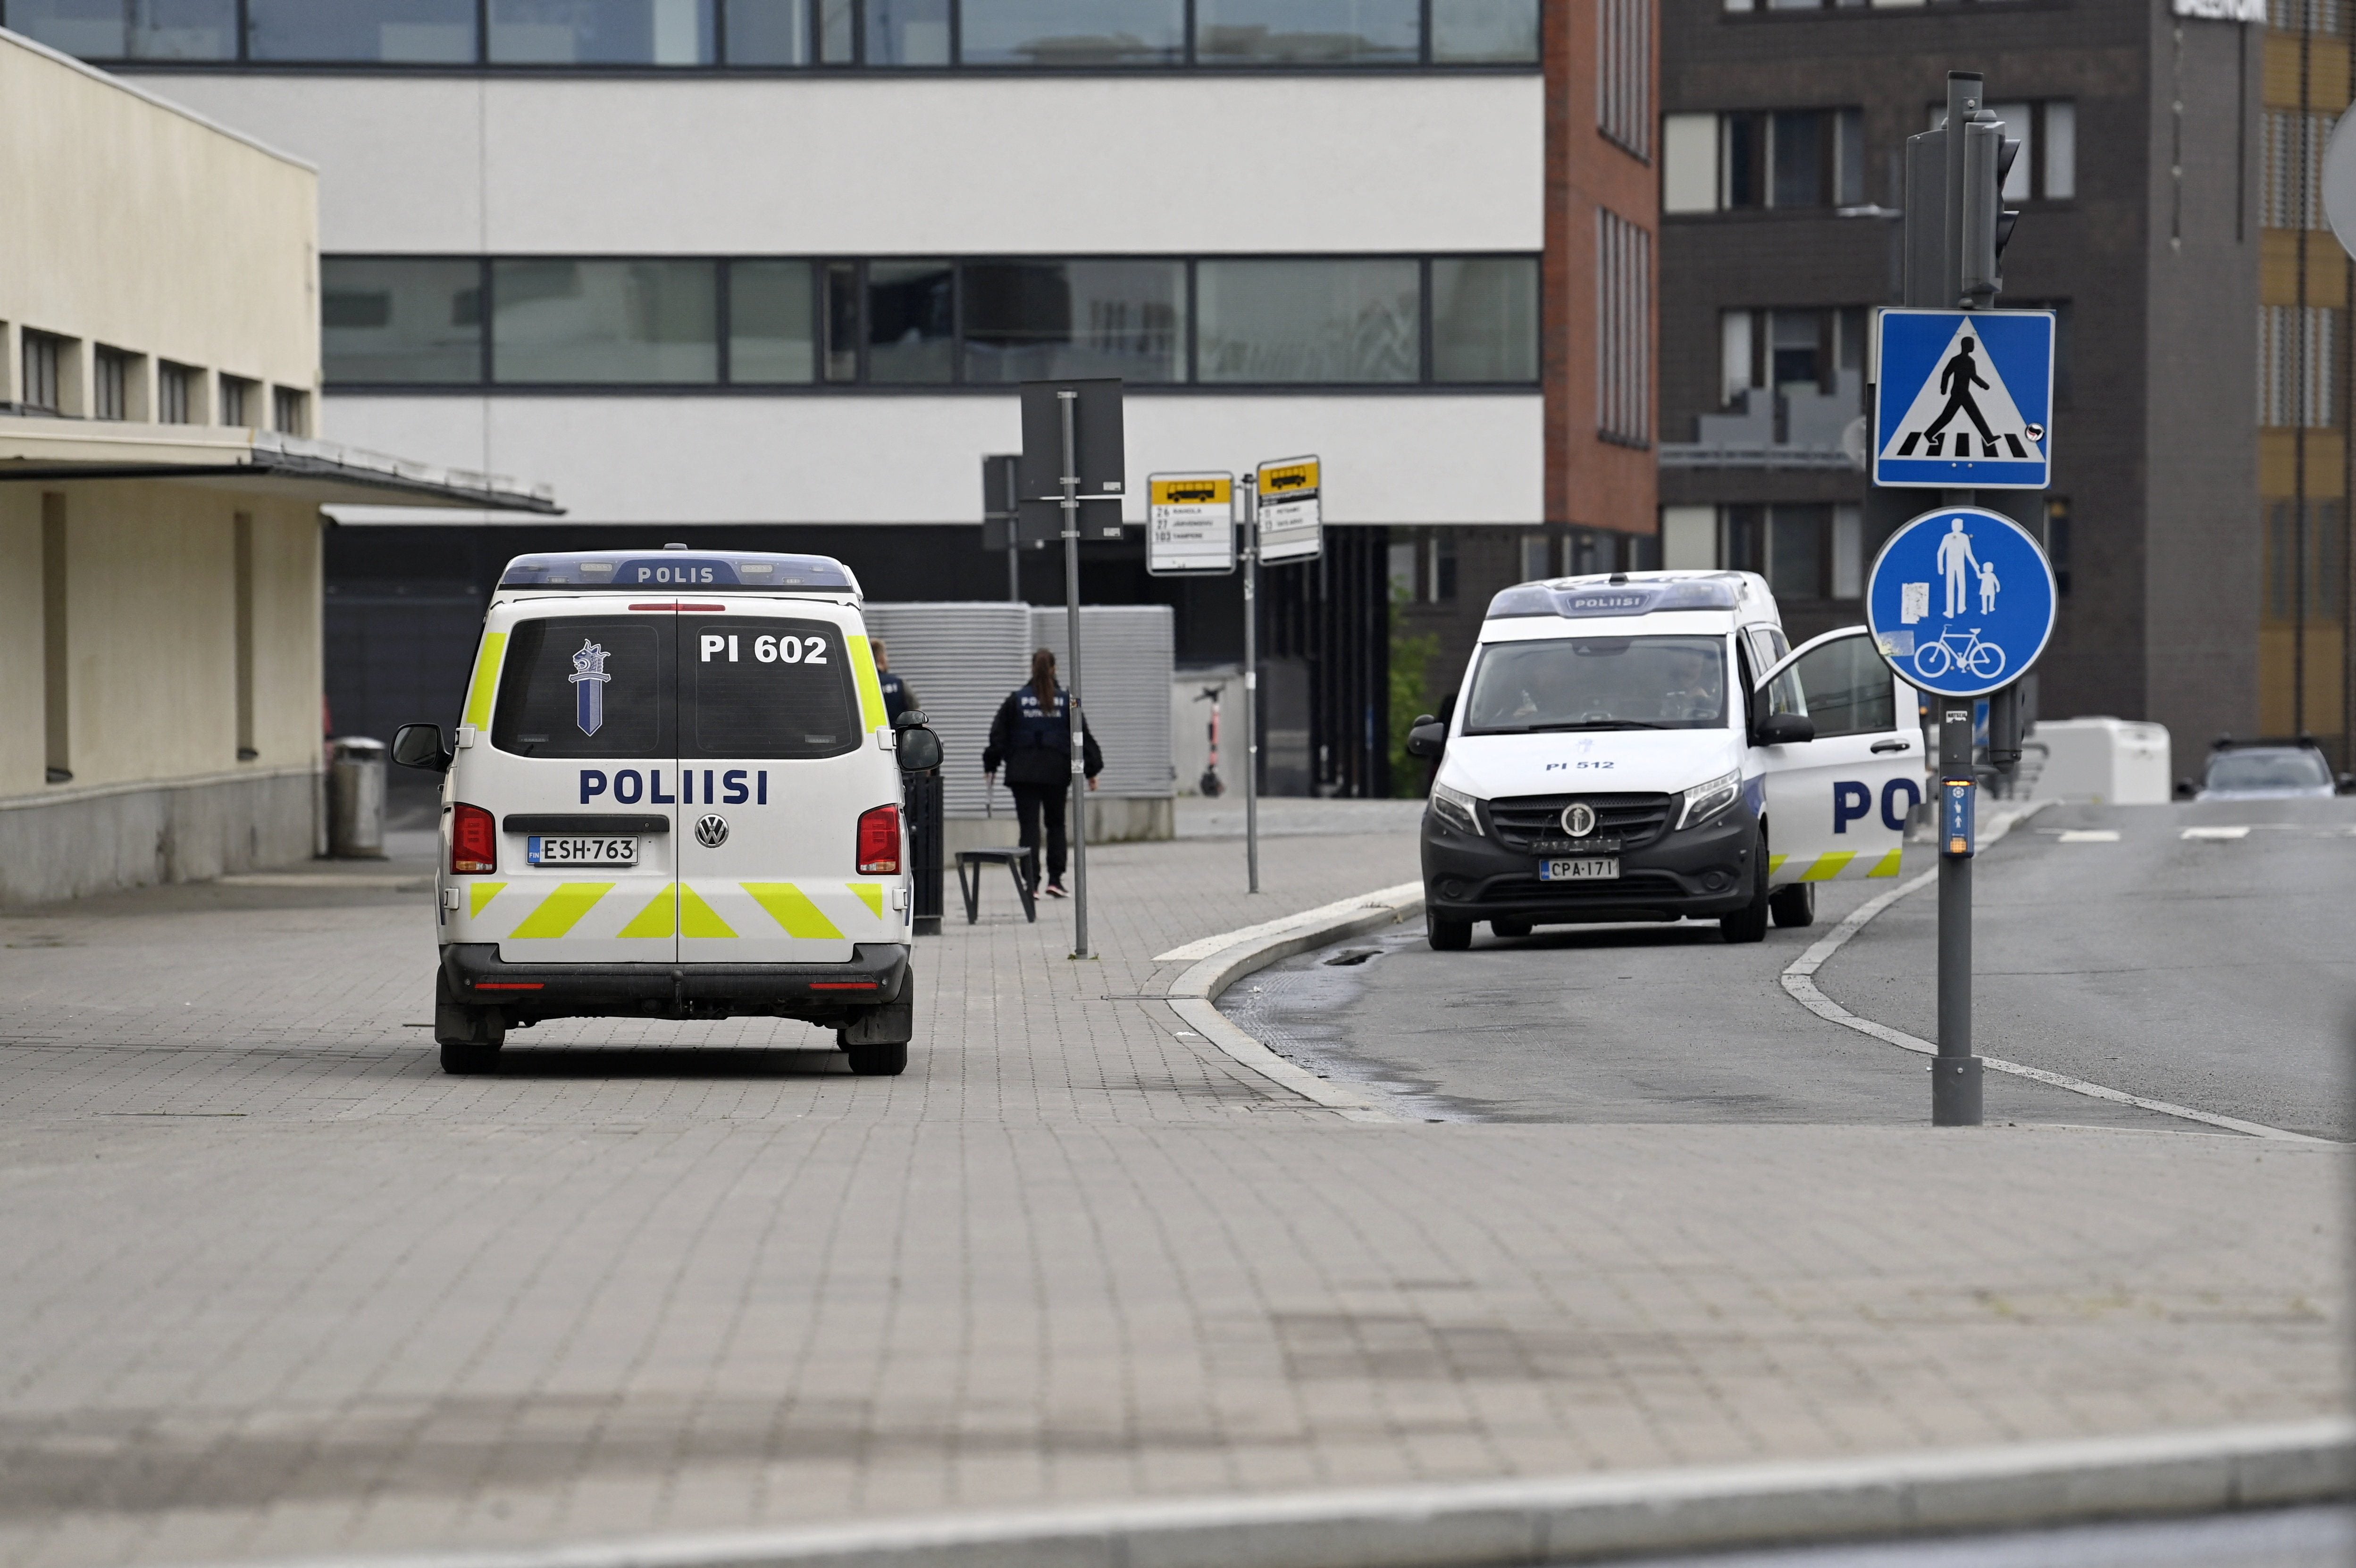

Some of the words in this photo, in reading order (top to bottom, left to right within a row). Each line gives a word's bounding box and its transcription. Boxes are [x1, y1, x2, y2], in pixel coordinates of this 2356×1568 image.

[1157, 508, 1169, 517] 26
[1157, 519, 1167, 529] 27
[638, 567, 713, 583] POLIS
[1575, 597, 1640, 608] POLIISI
[701, 635, 738, 662] PI
[755, 635, 827, 664] 602
[1546, 763, 1567, 771] PI
[580, 769, 767, 805] POLIISI
[1834, 778, 1921, 834] PO
[545, 840, 633, 859] ESH-763
[1552, 861, 1611, 876] CPA-171
